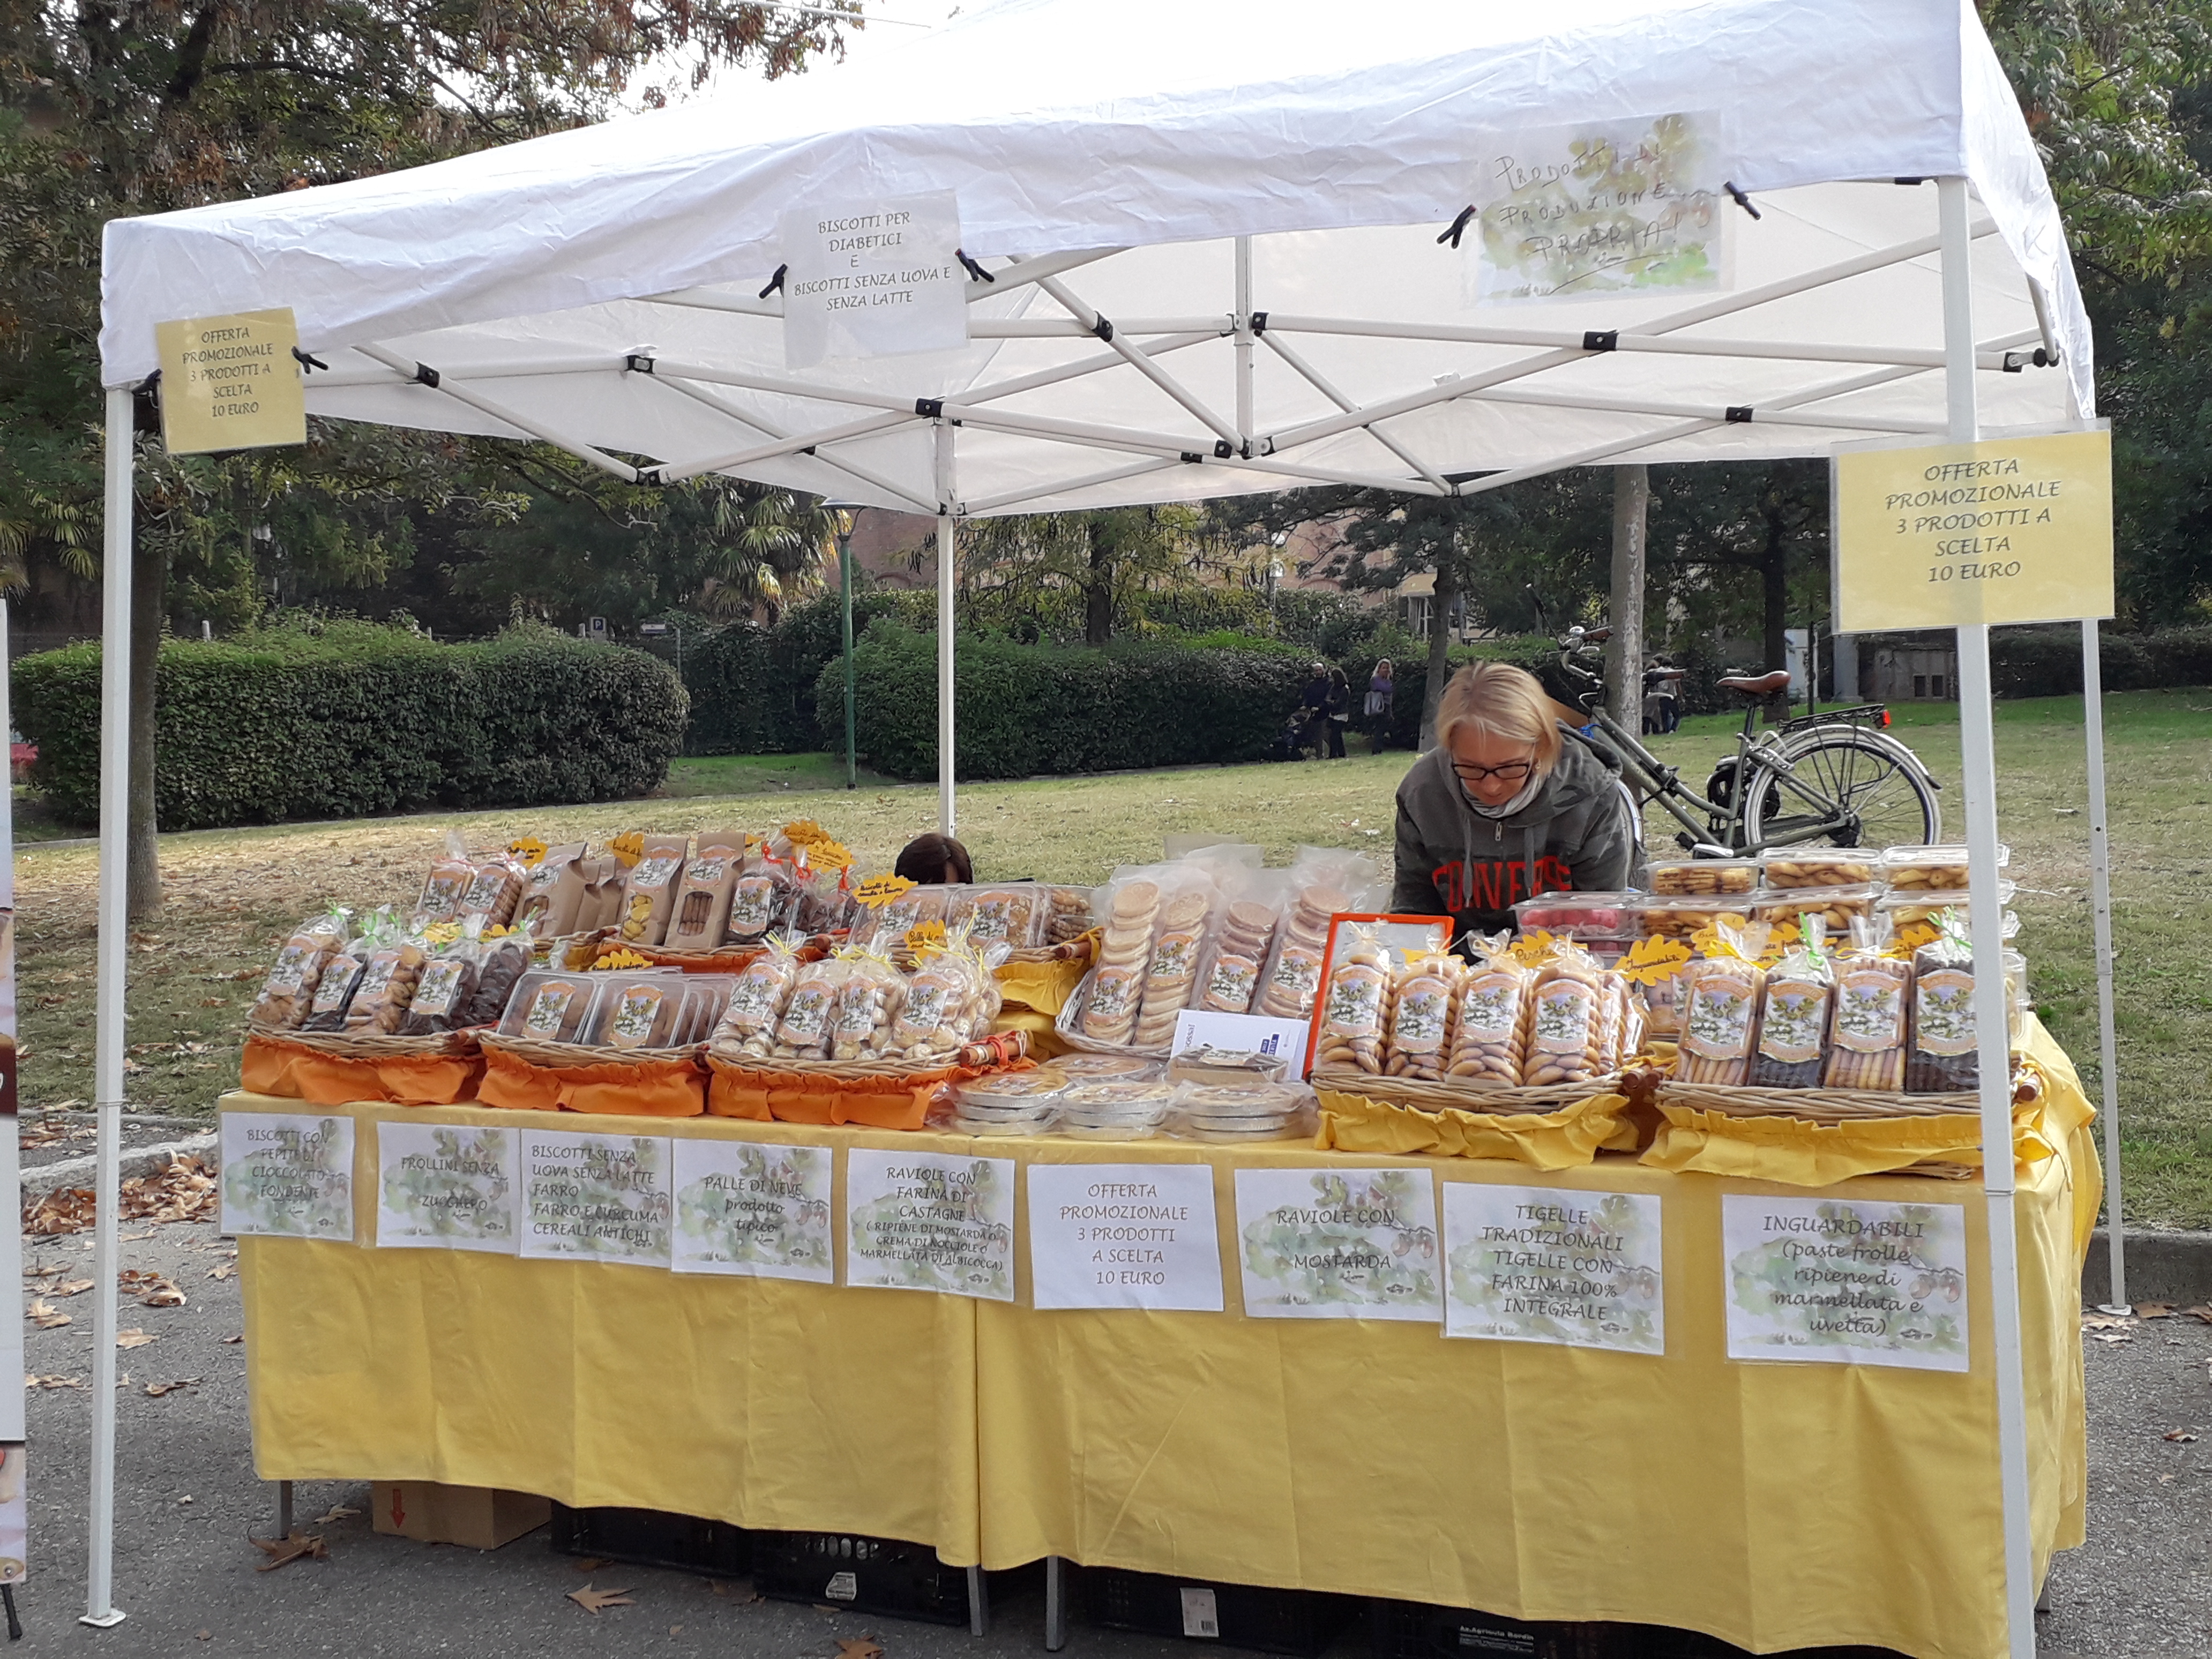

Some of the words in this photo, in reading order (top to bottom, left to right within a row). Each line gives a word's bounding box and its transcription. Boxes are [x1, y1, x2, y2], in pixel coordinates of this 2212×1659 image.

[818, 215, 881, 234] BISCOTTI
[886, 212, 910, 226] PER
[829, 233, 902, 252] DIABETICI
[850, 255, 859, 268] E
[794, 276, 850, 296] BISCOTTI
[855, 272, 896, 288] SENZA
[901, 267, 938, 283] UOVA
[944, 267, 951, 278] E
[826, 294, 867, 311] SENZA
[872, 290, 913, 305] LATTE
[201, 327, 250, 343] OFFERTA
[183, 343, 273, 364] PROMOZIONALE
[190, 370, 196, 382] 3
[201, 363, 258, 381] PRODOTTI
[263, 363, 271, 373] A
[214, 384, 253, 398] SCELTA
[212, 405, 225, 417] 10
[228, 402, 259, 415] EURO
[1924, 459, 2019, 482] OFFERTA
[1885, 481, 2061, 510] PROMOZIONALE
[1896, 519, 1906, 534] 3
[1915, 509, 2030, 533] PRODOTTI
[2036, 507, 2051, 523] A
[1935, 536, 2011, 557] SCELTA
[1928, 566, 1953, 582] 10
[1960, 561, 2021, 580] EURO
[246, 1130, 300, 1145] BISCOTTI
[532, 1145, 594, 1160] BISCOTTI
[597, 1149, 636, 1163] SENZA
[252, 1166, 325, 1181] CIOCCOLATO
[533, 1164, 568, 1176] UOVA
[573, 1167, 611, 1179] SENZA
[616, 1171, 654, 1184] LATTE
[886, 1167, 945, 1182] RAVIOLE
[948, 1172, 976, 1185] CON
[260, 1185, 319, 1198] FONDENTE
[534, 1184, 579, 1197] FARRO
[704, 1177, 746, 1190] PALLE
[750, 1180, 765, 1192] DI
[771, 1182, 803, 1195] NEVE
[896, 1186, 947, 1201] FARINA
[951, 1191, 966, 1202] DI
[1088, 1184, 1157, 1198] OFFERTA
[534, 1203, 579, 1216] FARRO
[596, 1207, 658, 1223] CURCUMA
[726, 1198, 785, 1214] prodotto
[900, 1206, 965, 1222] CASTAGNE
[1060, 1205, 1188, 1220] PROMOZIONALE
[1515, 1205, 1588, 1224] TIGELLE
[1276, 1209, 1352, 1224] RAVIOLE
[1358, 1209, 1394, 1223] CON
[534, 1222, 589, 1236] CEREALI
[594, 1225, 651, 1242] ANTICHI
[736, 1219, 780, 1235] tipico
[921, 1224, 933, 1233] DI
[937, 1225, 985, 1239] MOSTARDA
[1078, 1228, 1086, 1240] 3
[1092, 1227, 1175, 1242] PRODOTTI
[1762, 1216, 1924, 1238] INGUARDABILI
[876, 1236, 911, 1246] CREMA
[914, 1238, 926, 1247] DI
[930, 1239, 977, 1252] NOCCIOLE
[1482, 1227, 1624, 1251] TRADIZIONALI
[860, 1249, 928, 1261] MARMELLATA
[1092, 1250, 1102, 1262] A
[1108, 1249, 1164, 1263] SCELTA
[1782, 1240, 1848, 1259] (paste
[1852, 1245, 1912, 1262] frolle
[1295, 1254, 1391, 1269] MOSTARDA
[1493, 1251, 1567, 1269] TIGELLE
[1573, 1257, 1613, 1274] CON
[1097, 1271, 1115, 1284] 10
[1120, 1271, 1164, 1284] EURO
[1492, 1274, 1563, 1292] FARINA
[1571, 1280, 1617, 1298] 100%
[1794, 1269, 1872, 1286] ripiene
[1875, 1271, 1901, 1286] di
[1504, 1298, 1607, 1320] INTEGRALE
[1774, 1293, 1904, 1311] marmellata
[1910, 1302, 1924, 1312] e
[1810, 1317, 1886, 1336] uvetta)
